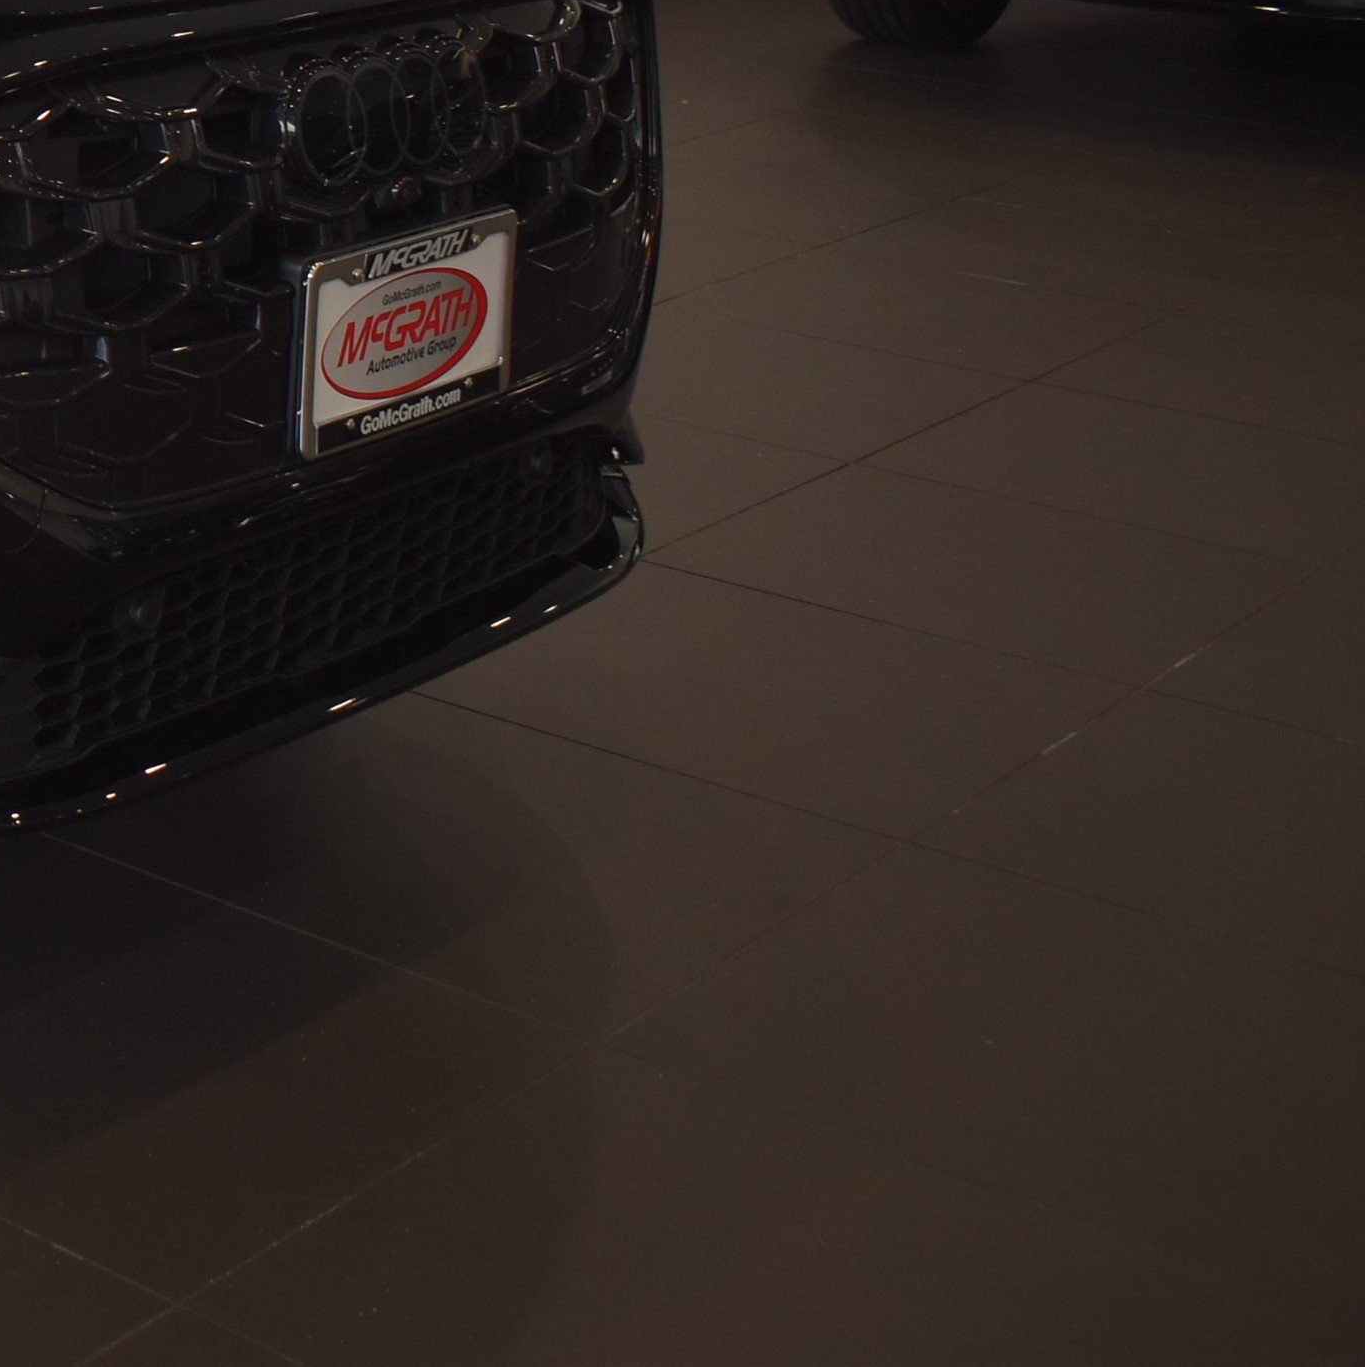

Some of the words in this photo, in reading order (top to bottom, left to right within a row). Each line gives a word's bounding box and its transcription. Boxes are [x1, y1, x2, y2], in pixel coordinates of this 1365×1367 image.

[382, 280, 442, 306] GoMcGrath.com
[366, 347, 425, 376] Automotive
[426, 335, 457, 356] Group
[360, 387, 461, 435] GoMcGrath.com
